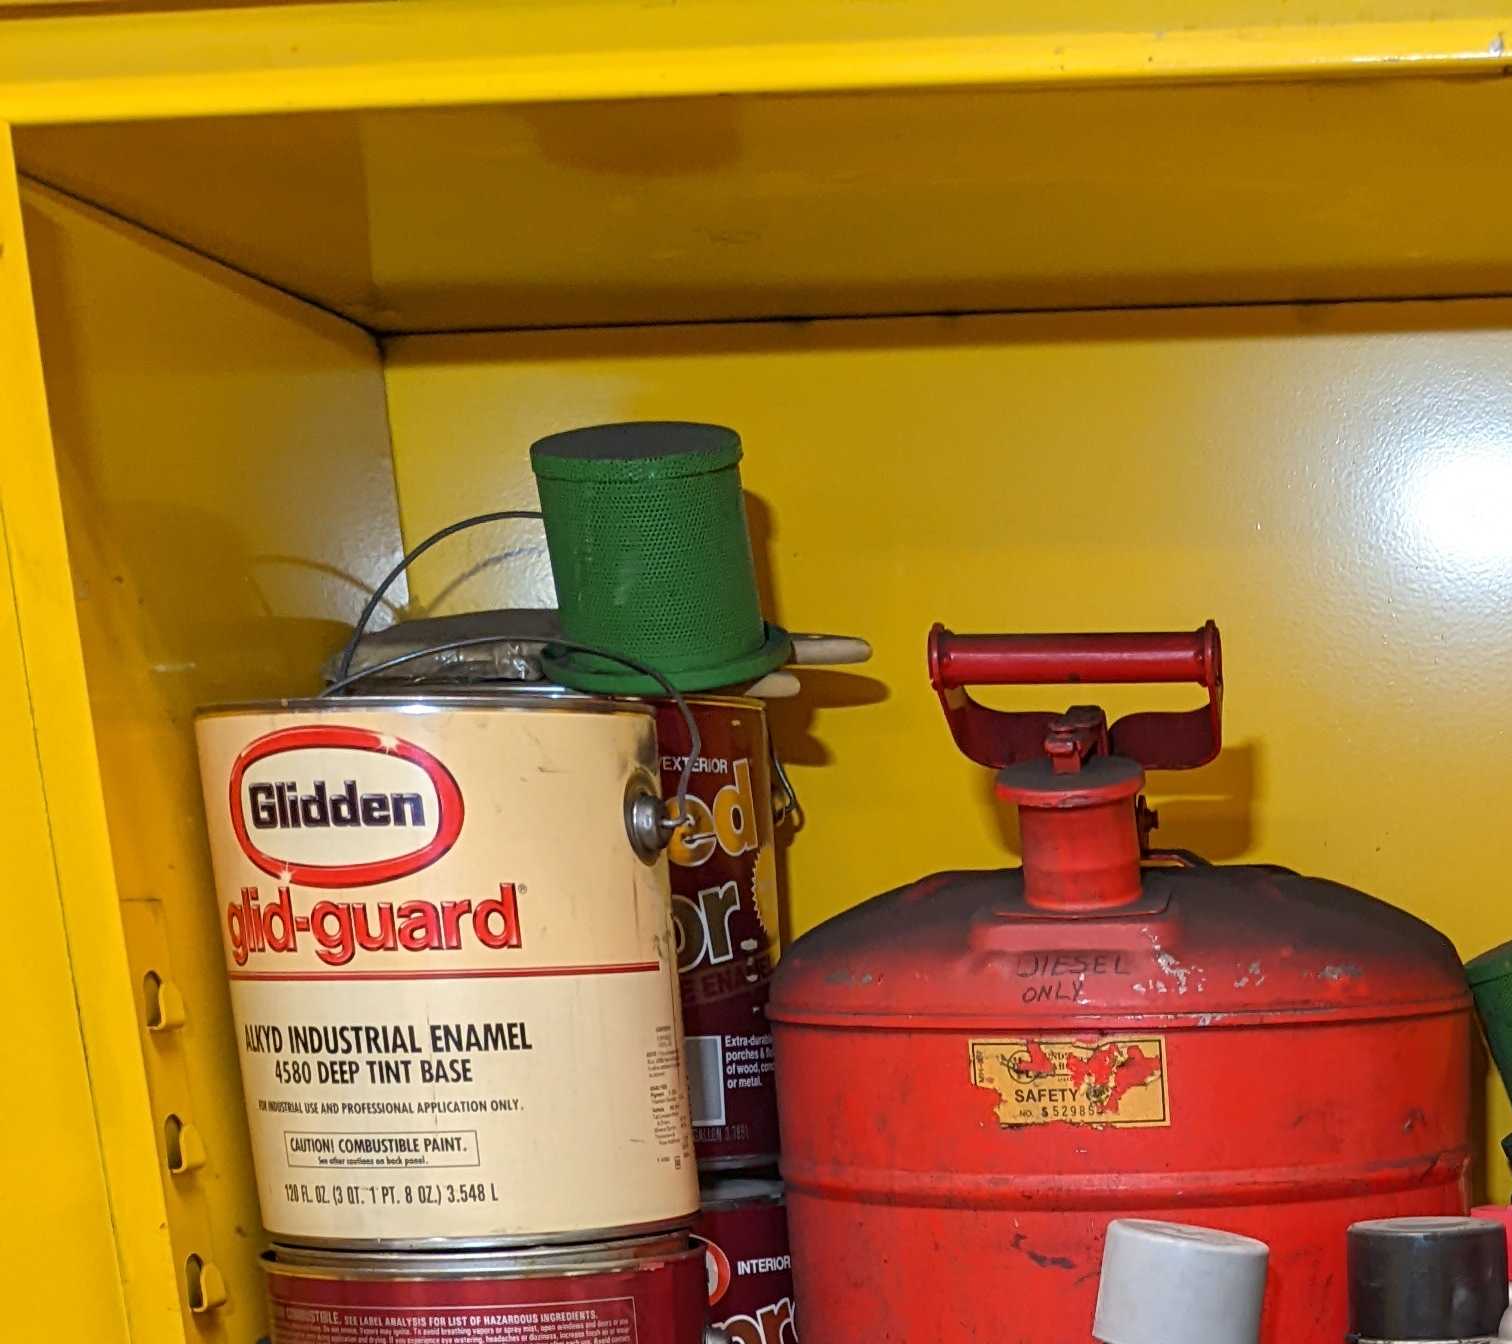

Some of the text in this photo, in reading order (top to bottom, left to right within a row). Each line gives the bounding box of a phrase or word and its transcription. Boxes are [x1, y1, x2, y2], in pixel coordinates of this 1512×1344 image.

[248, 780, 426, 829] Glidden
[228, 882, 522, 966] glid-guard
[1021, 981, 1084, 1004] ONLY
[244, 1022, 532, 1054] ALKYD INDUSTRIAL ENAMEL
[275, 1059, 473, 1084] 4580 DEEP TINT BASE
[268, 1100, 302, 1114] INDUSTRIAL
[305, 1102, 319, 1114] USE
[321, 1103, 340, 1114] AND
[342, 1102, 415, 1114] PROFESSIONAL
[417, 1101, 488, 1114] APPLICATION
[491, 1100, 524, 1112] ONLY.
[1014, 1088, 1078, 1103] SAFETY
[290, 1136, 468, 1153] CAUTION! COMBUSTIBLE PAINT.
